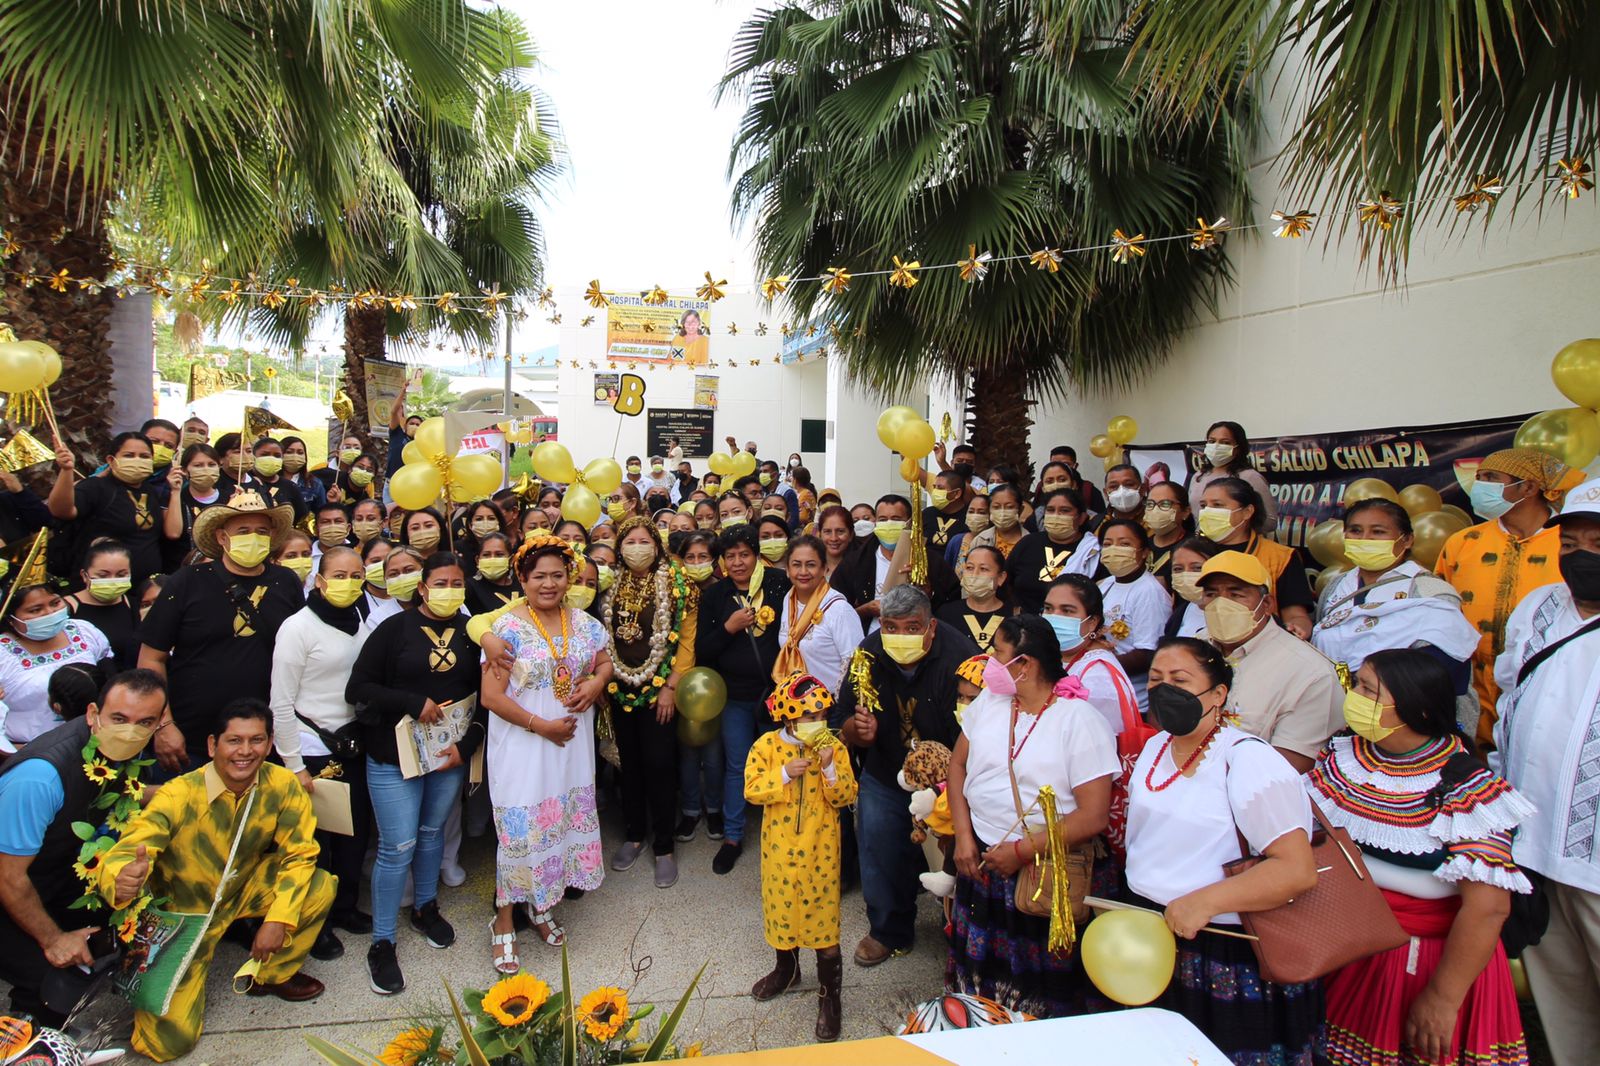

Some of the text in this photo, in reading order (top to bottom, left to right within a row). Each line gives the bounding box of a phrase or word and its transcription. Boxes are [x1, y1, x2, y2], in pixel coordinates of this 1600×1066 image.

[610, 296, 643, 306] HOSPITAL
[680, 300, 708, 310] CHILAPA
[614, 374, 646, 416] B
[462, 437, 490, 449] TAL
[1270, 448, 1327, 472] SALUD
[1333, 441, 1430, 470] CHILAPA
[1270, 484, 1314, 506] POYO
[1318, 484, 1331, 506] A
